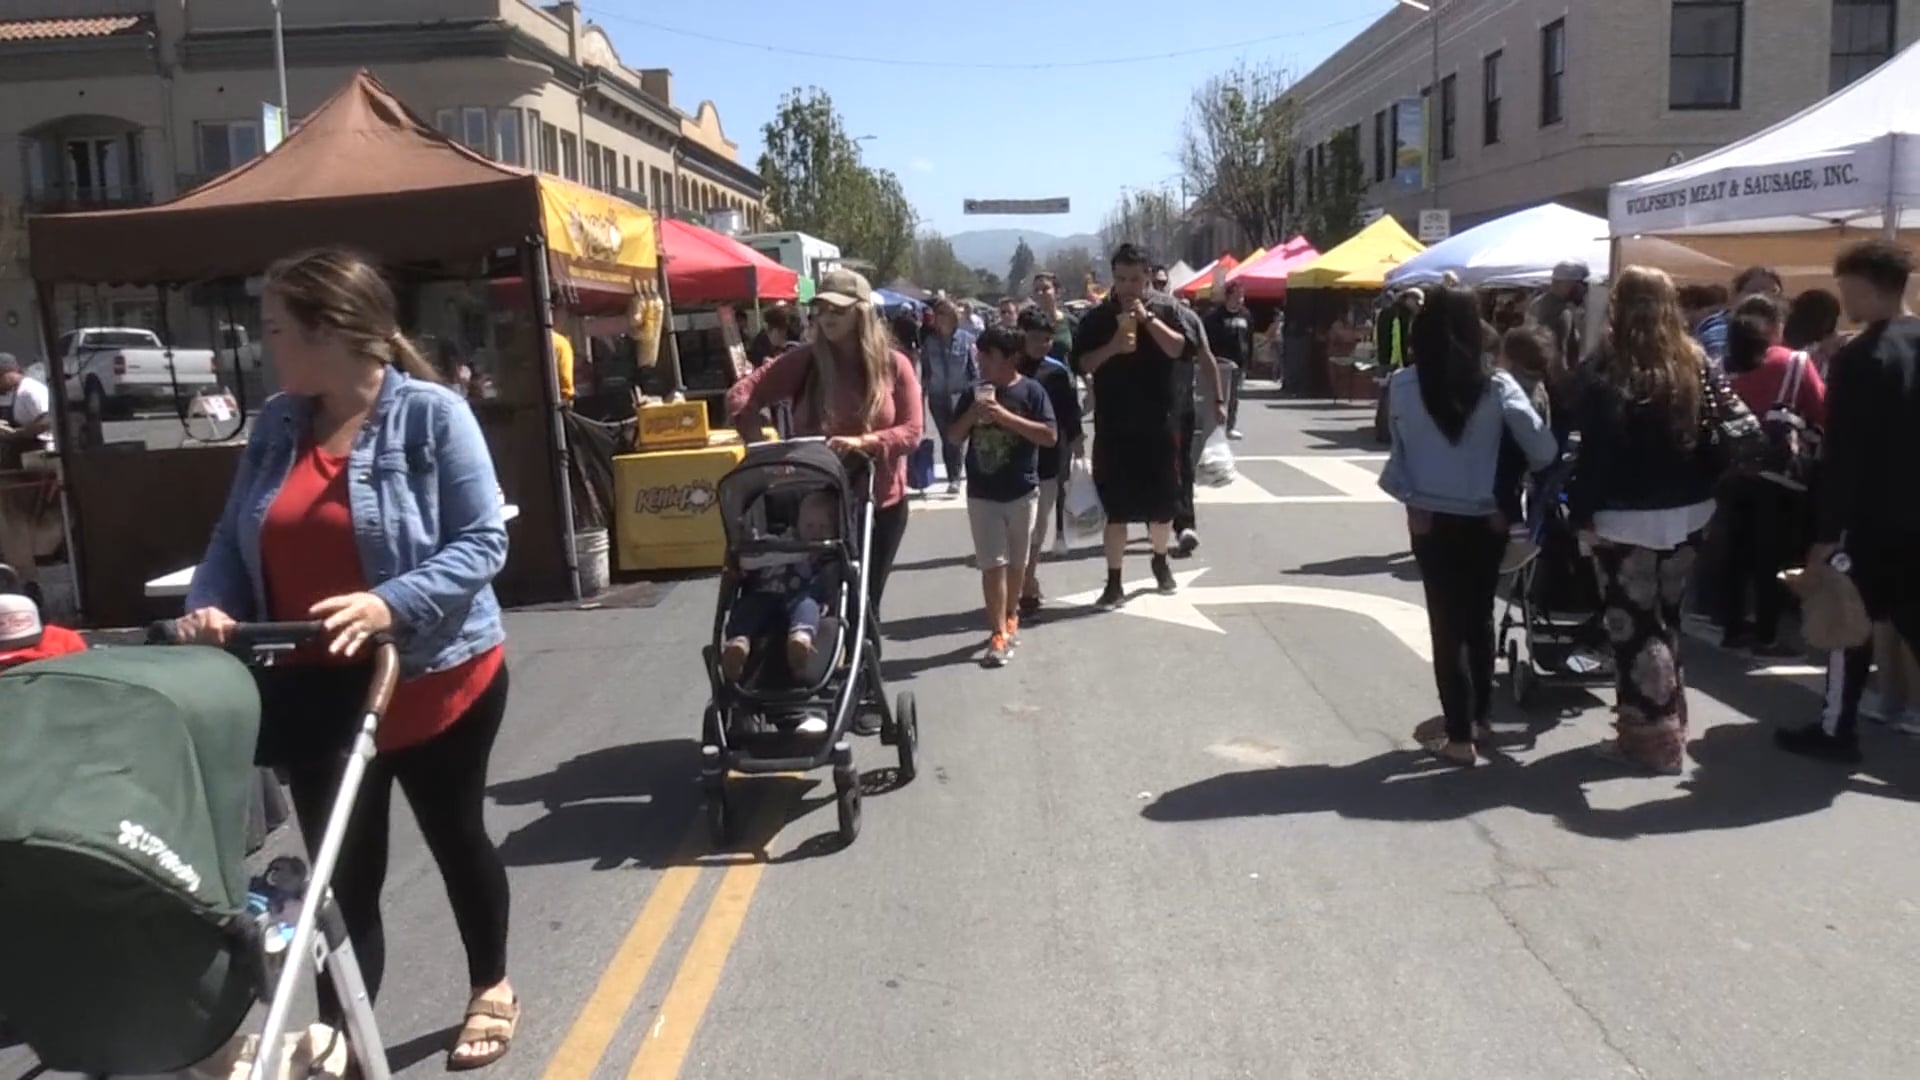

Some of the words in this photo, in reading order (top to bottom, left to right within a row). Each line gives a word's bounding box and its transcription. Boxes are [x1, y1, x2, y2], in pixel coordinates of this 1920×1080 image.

[1626, 190, 1687, 215] WOLFSEN'S
[1690, 182, 1726, 204] MEAT
[1728, 181, 1740, 197] &
[1743, 170, 1818, 196] SAUSAGE,
[1823, 163, 1859, 187] INC.
